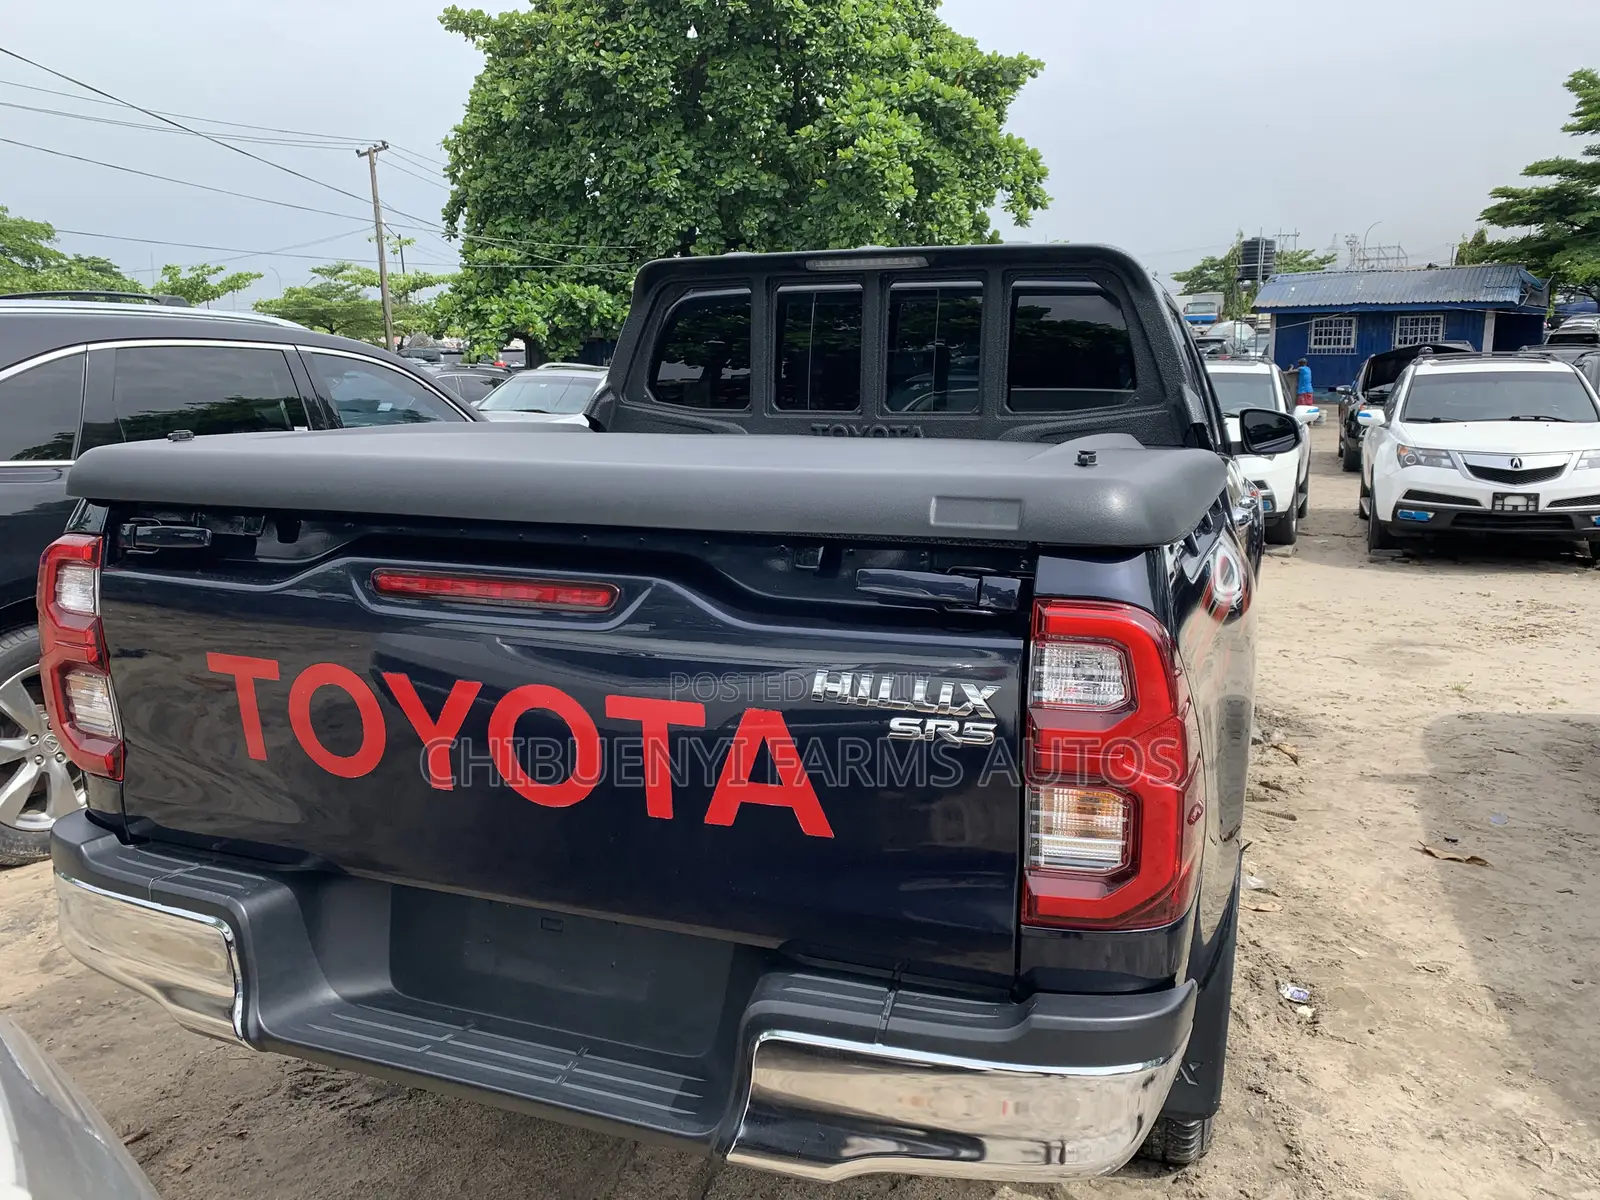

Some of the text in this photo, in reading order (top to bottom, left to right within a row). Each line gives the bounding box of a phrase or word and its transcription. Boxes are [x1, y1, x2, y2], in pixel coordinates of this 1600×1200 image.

[811, 669, 1001, 719] HILUX
[206, 652, 834, 838] TOYOTA
[887, 716, 999, 745] SR5
